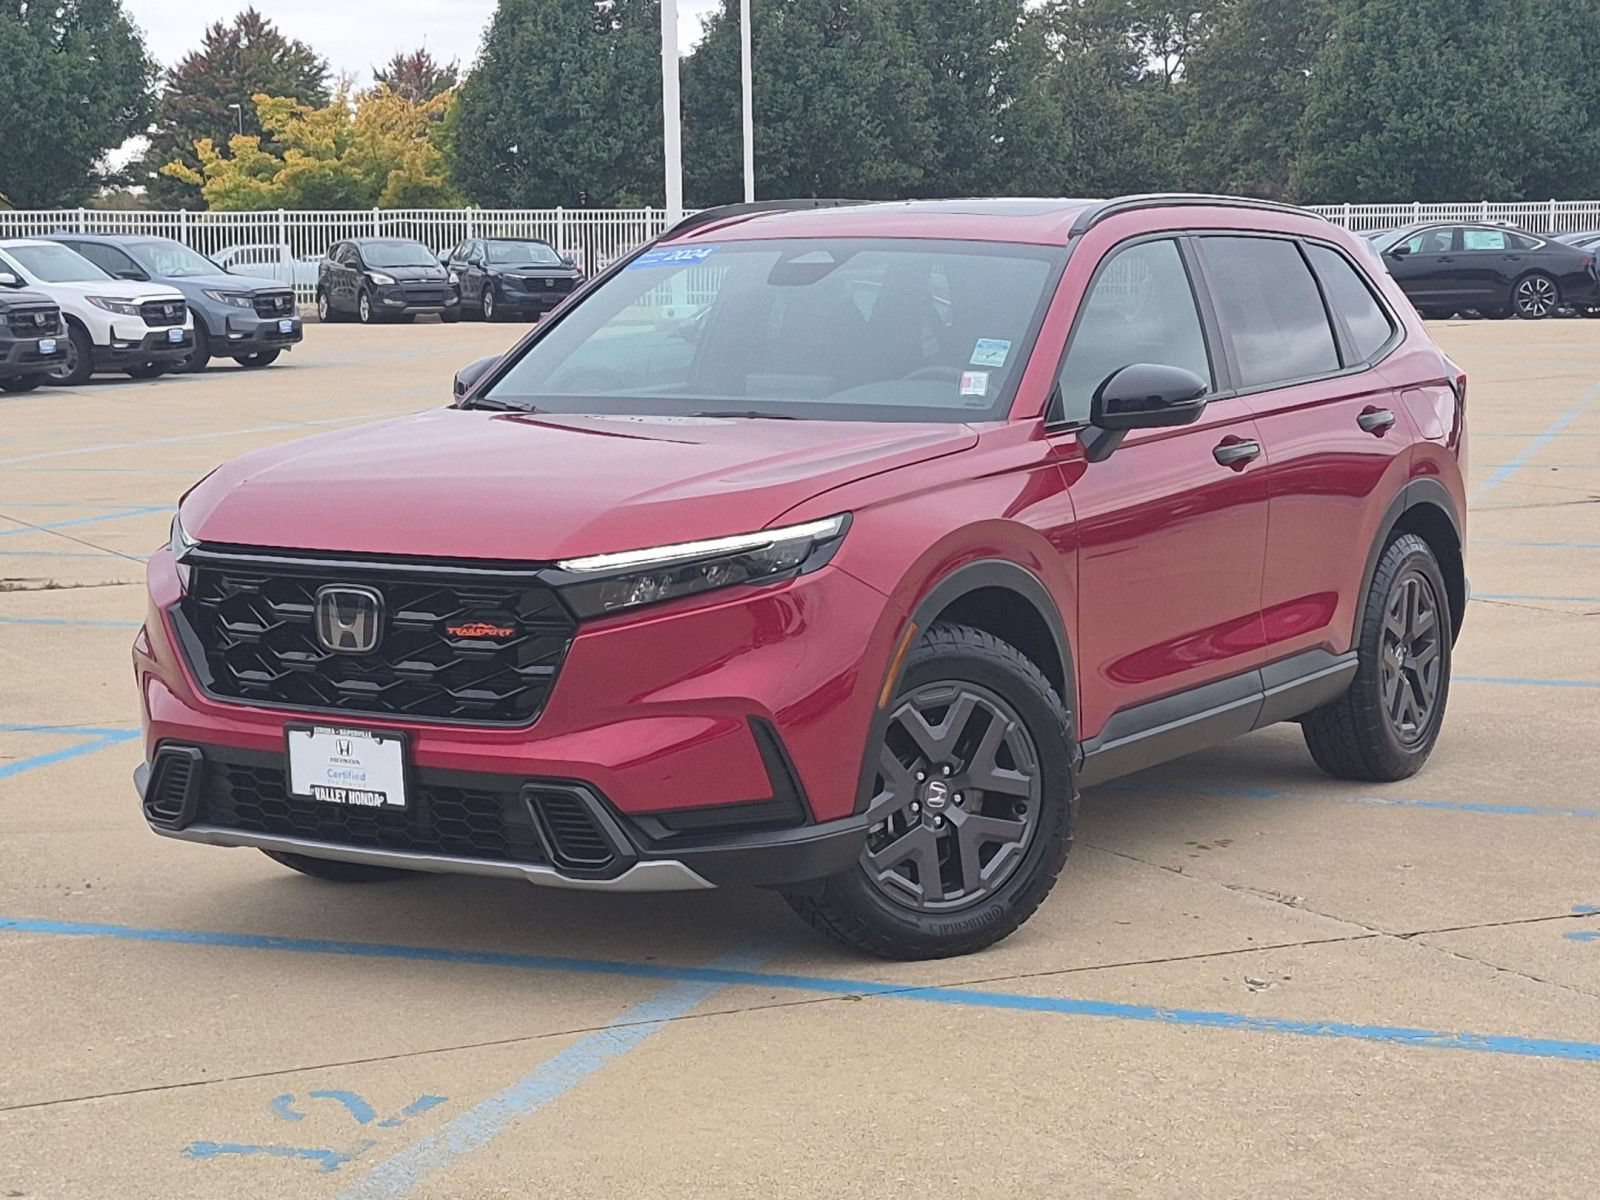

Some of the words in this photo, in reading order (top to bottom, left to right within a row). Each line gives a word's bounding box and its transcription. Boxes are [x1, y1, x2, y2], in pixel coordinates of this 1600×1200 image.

[330, 757, 361, 765] HONDA
[327, 769, 366, 781] Certified
[314, 787, 347, 803] VALLEY
